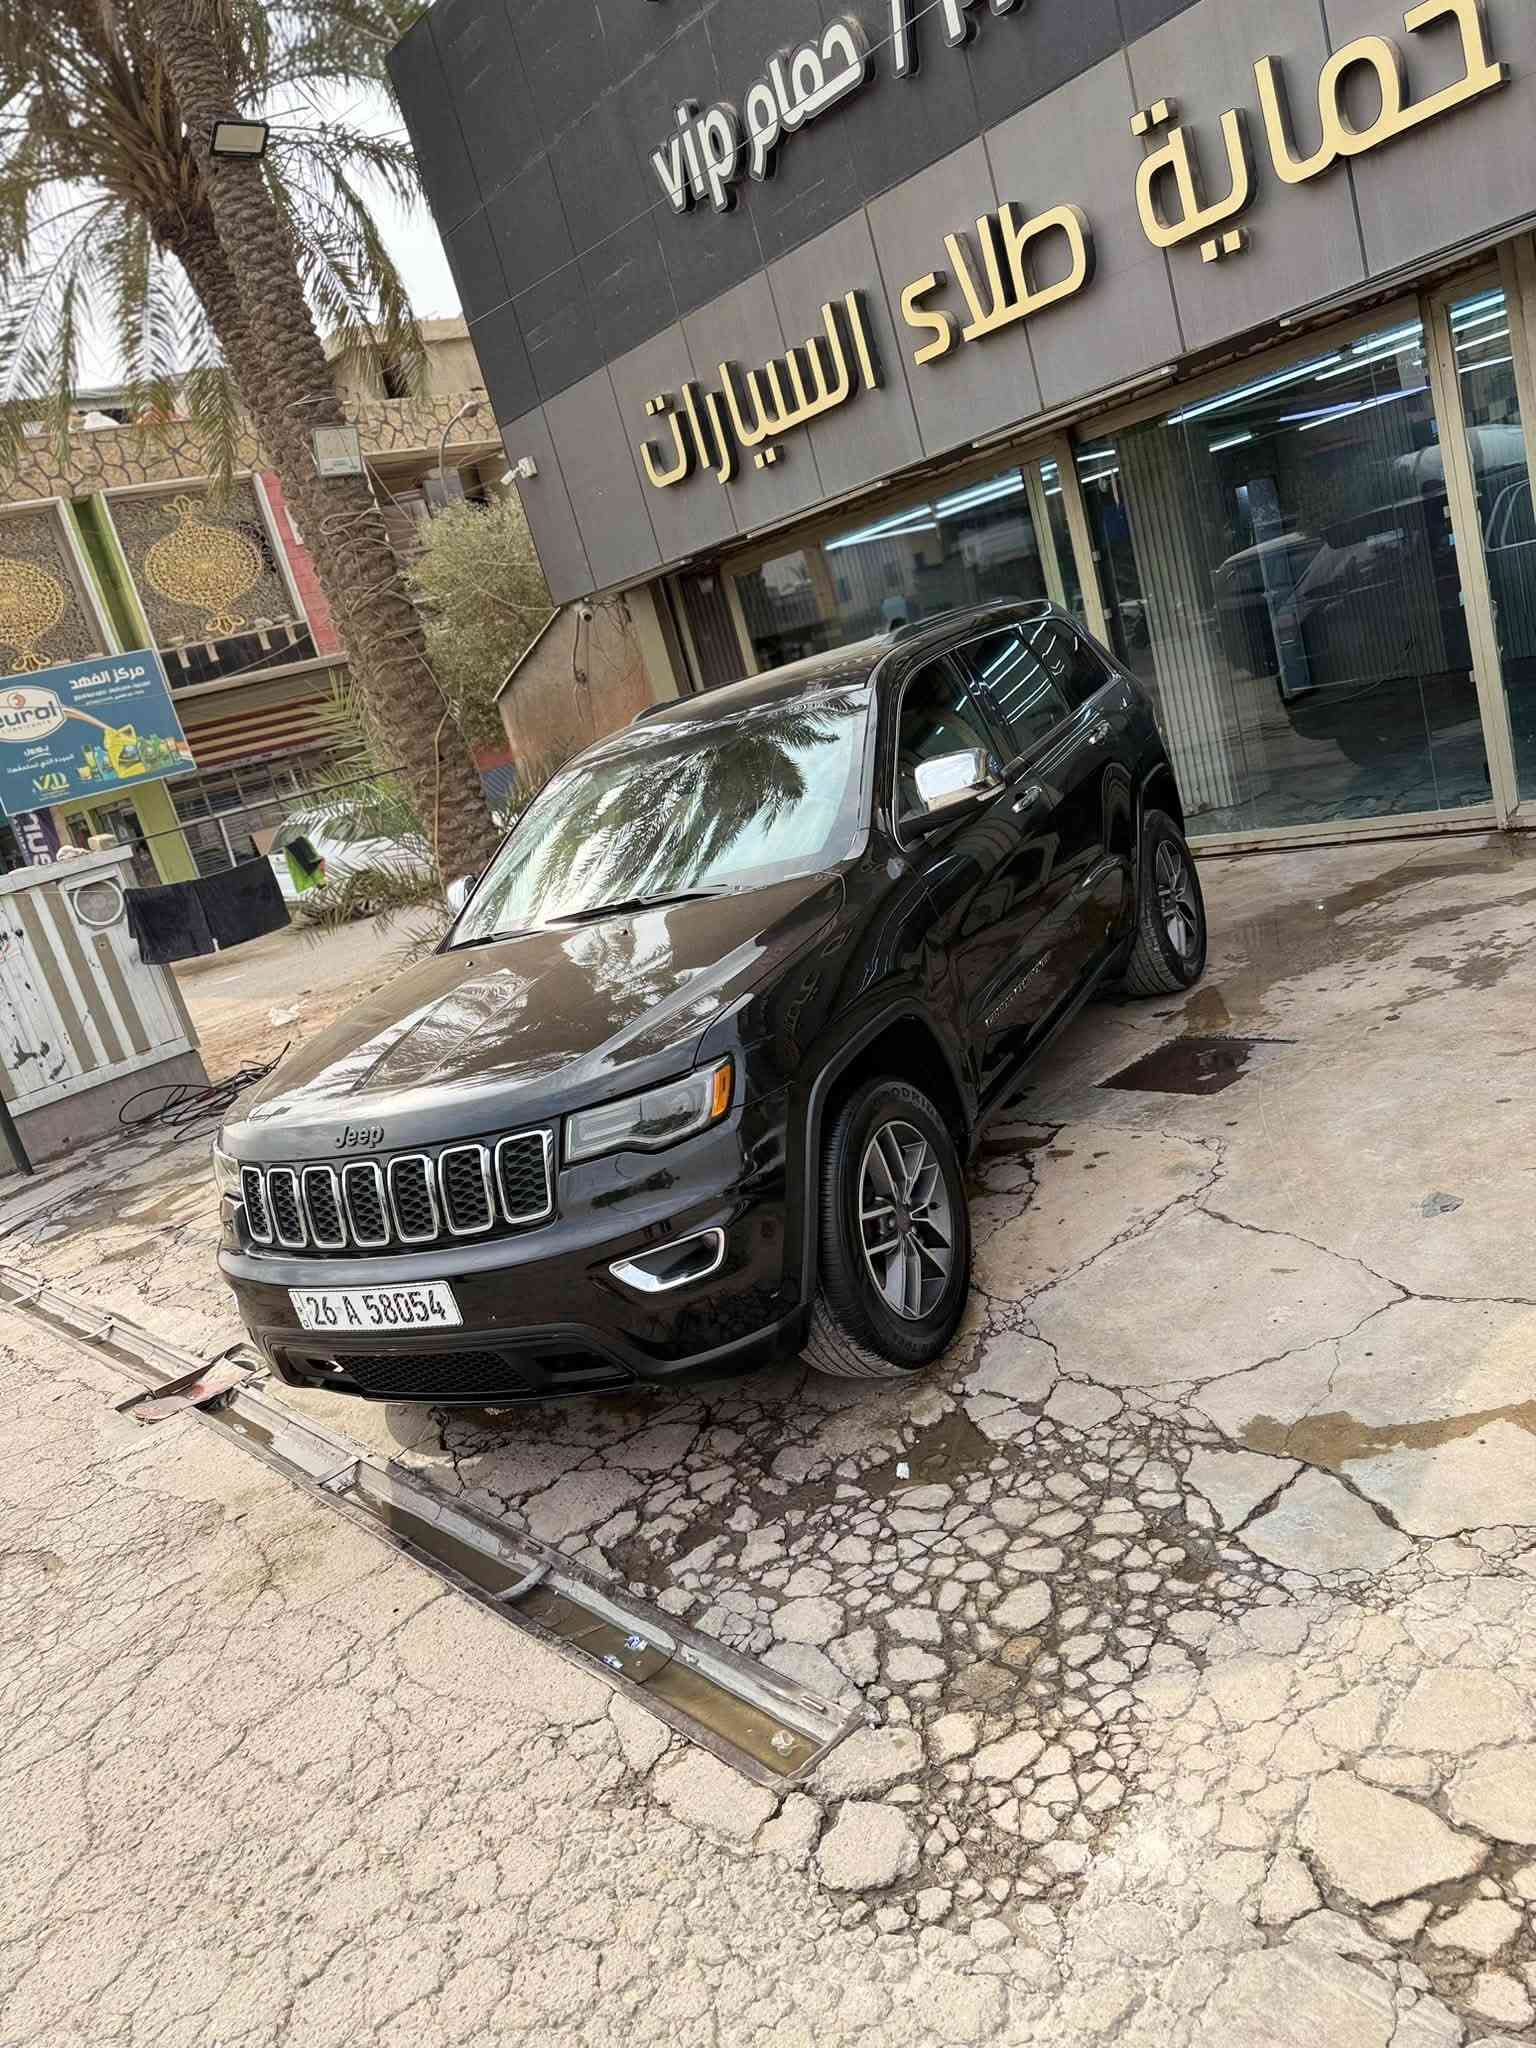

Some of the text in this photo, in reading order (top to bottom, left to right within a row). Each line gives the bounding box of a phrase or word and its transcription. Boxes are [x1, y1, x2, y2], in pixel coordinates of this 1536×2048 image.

[747, 24, 861, 175] حمام
[651, 105, 736, 208] vip
[640, 0, 1501, 488] حماية طلاء السيارات
[68, 666, 145, 690] مركز الفهد
[335, 1125, 385, 1149] Jeep
[306, 1296, 337, 1325] 26
[342, 1295, 362, 1325] A
[362, 1290, 447, 1325] 58054
